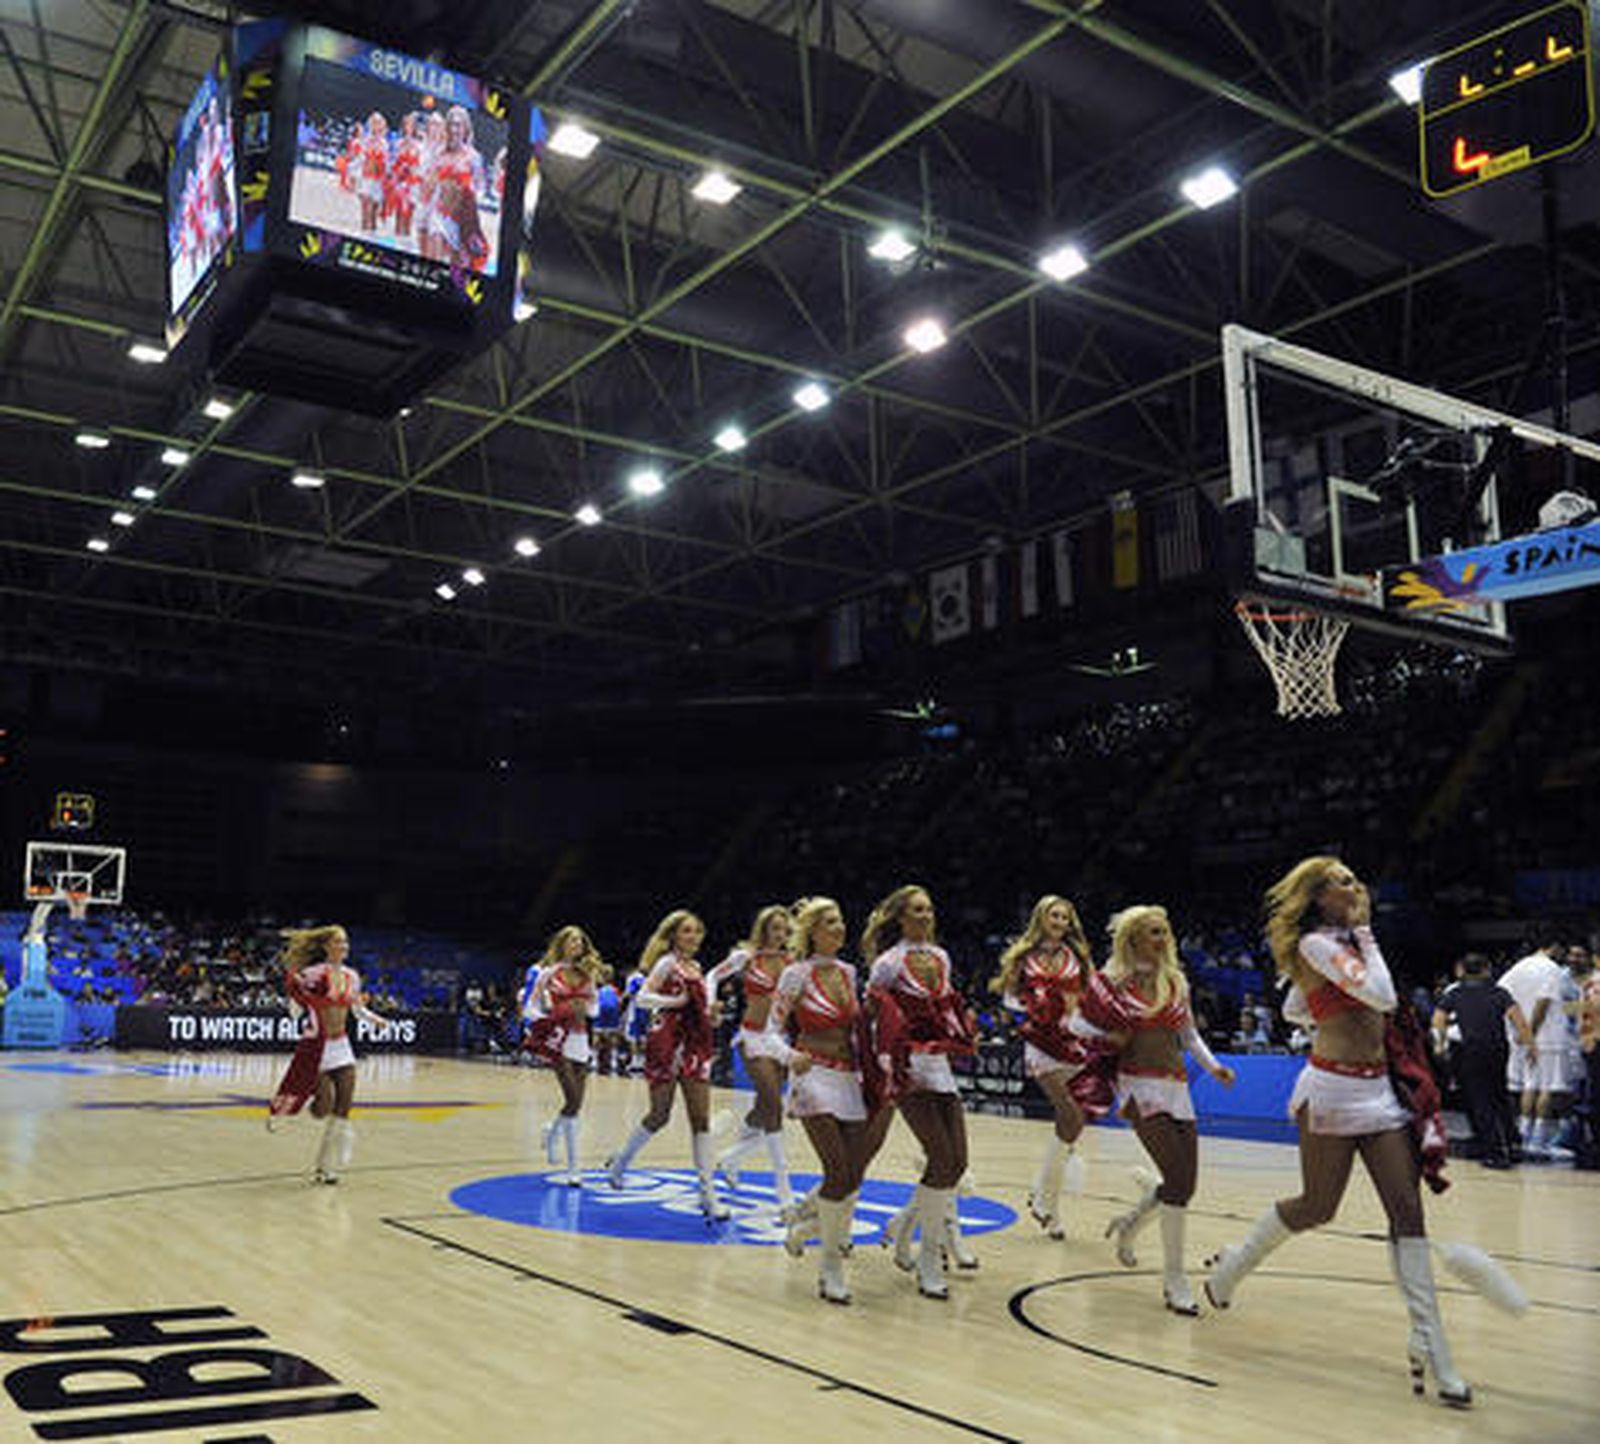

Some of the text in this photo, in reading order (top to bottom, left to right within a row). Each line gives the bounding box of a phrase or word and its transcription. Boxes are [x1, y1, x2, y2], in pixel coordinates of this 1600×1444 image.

[369, 48, 456, 98] SEVILLA
[169, 1016, 196, 1040] TO
[201, 1016, 273, 1040] WATCH
[357, 1019, 416, 1042] PLAYS
[0, 1305, 379, 1444] IBA
